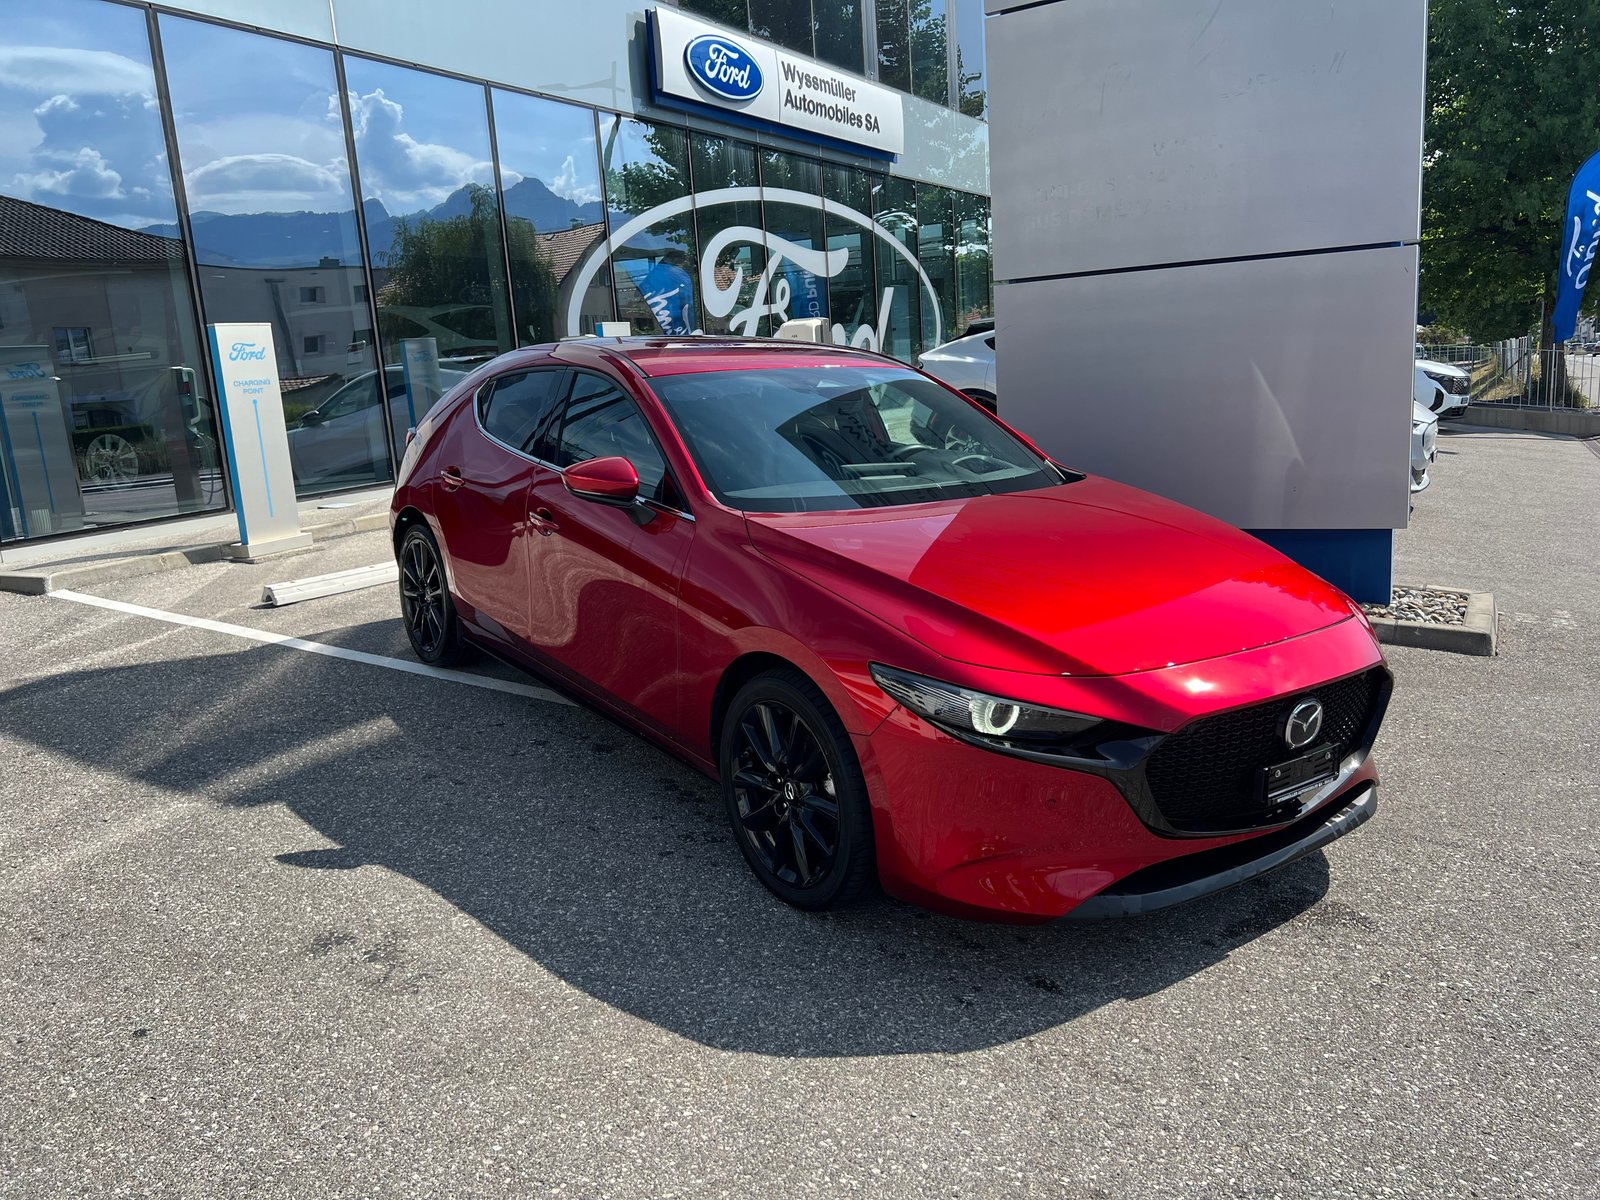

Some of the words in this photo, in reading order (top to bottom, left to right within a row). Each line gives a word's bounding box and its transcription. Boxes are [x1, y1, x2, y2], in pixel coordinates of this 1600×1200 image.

[705, 44, 751, 89] Ford
[781, 61, 857, 103] Wyssmüller
[783, 90, 863, 128] Automobiles
[864, 114, 881, 134] SA
[229, 342, 266, 361] Ford
[233, 379, 271, 387] CHARGING
